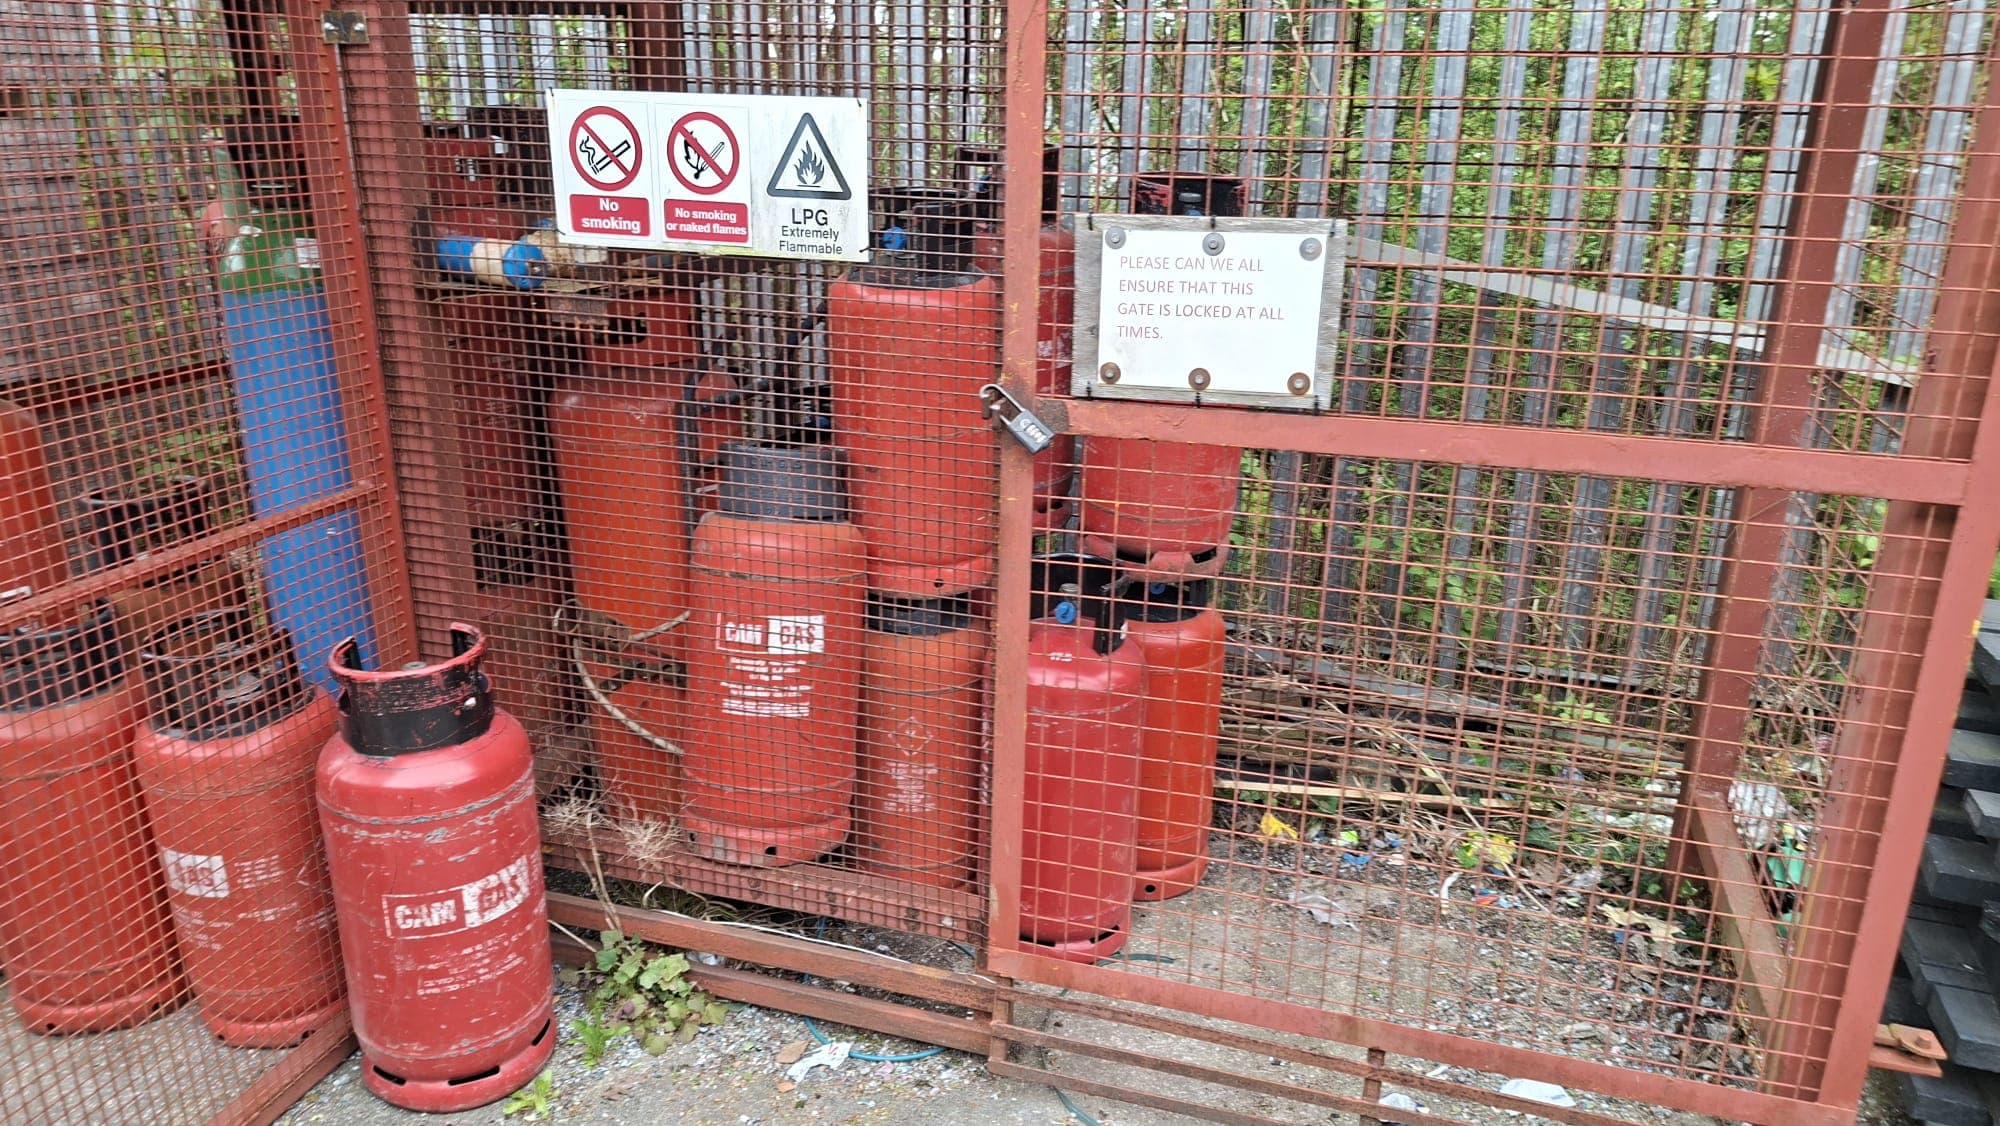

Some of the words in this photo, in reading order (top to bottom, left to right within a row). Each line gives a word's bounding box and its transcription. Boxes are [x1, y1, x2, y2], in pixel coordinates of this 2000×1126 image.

[599, 198, 619, 213] No
[675, 207, 690, 219] No
[692, 209, 737, 224] smoking
[792, 208, 828, 226] LPG
[581, 217, 641, 234] smoking
[666, 222, 679, 232] or
[682, 222, 710, 234] naked
[713, 225, 747, 237] flames
[781, 226, 840, 243] Extremely
[779, 241, 843, 256] Flammable
[1120, 256, 1170, 270] PLEASE
[1175, 256, 1205, 271] CAN
[1210, 258, 1233, 272] WE
[1238, 259, 1264, 273] ALL
[1119, 280, 1174, 293] ENSURE
[1180, 281, 1216, 295] THAT
[1222, 282, 1254, 295] THIS
[1118, 303, 1154, 316] GATE
[1159, 304, 1171, 317] IS
[1175, 304, 1232, 318] LOCKED
[1236, 306, 1255, 319] AT
[1259, 307, 1285, 320] ALL
[1117, 326, 1163, 339] TIMES.
[781, 626, 815, 644] GAS
[394, 900, 456, 929] CAM
